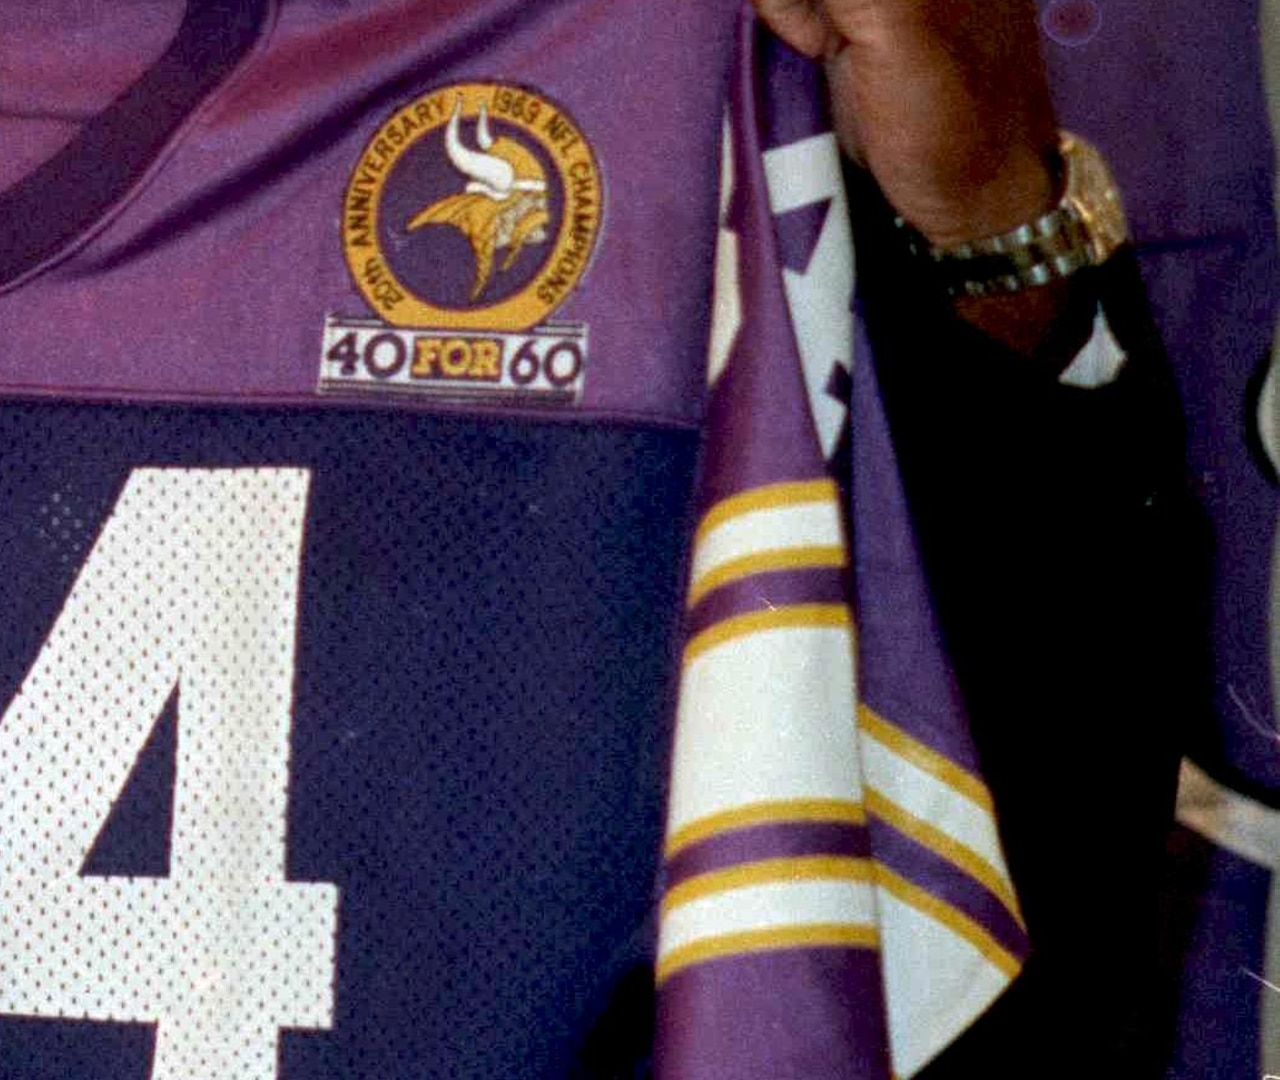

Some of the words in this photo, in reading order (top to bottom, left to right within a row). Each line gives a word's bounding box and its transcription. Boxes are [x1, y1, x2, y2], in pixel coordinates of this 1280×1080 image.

[491, 87, 541, 125] 1969
[541, 113, 579, 159] NFL
[347, 98, 445, 248] ANNIVERSARY
[537, 161, 596, 305] CHAMPIONS
[326, 332, 408, 379] 40
[411, 337, 503, 378] FOR
[510, 340, 584, 388] 60
